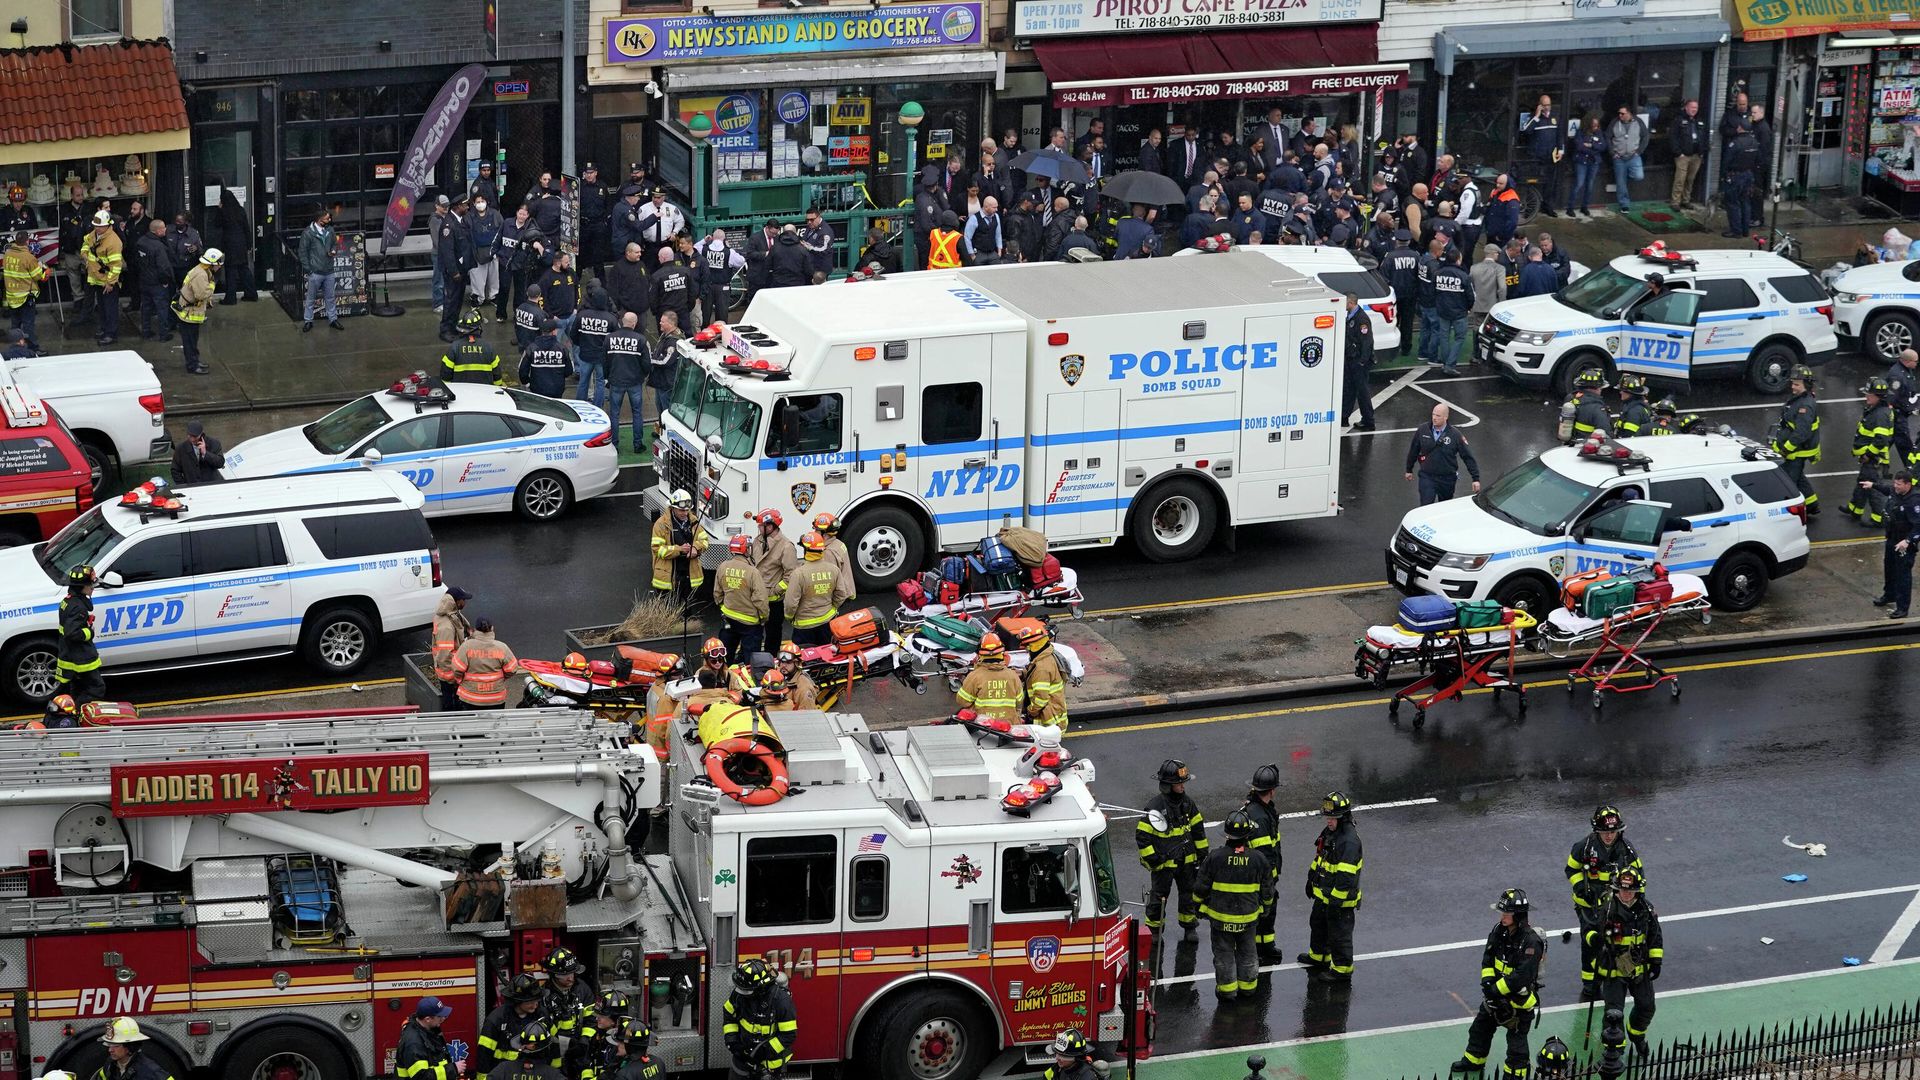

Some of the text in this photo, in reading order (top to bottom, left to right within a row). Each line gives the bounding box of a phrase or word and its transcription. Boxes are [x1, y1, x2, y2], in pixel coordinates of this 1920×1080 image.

[1023, 4, 1083, 17] OPEN 7 DAYS
[1795, 0, 1846, 16] FRUITS
[663, 18, 687, 27] LOTTO
[693, 17, 713, 26] SODA
[720, 16, 745, 25] CANDY
[752, 14, 794, 22] CIGARETTES
[801, 12, 823, 20] CIGAR
[850, 10, 867, 18] BEER
[874, 7, 922, 17] STATIONERIES
[927, 6, 941, 14] ETC
[1115, 11, 1285, 29] TEL: 718-840-5780 718-840-5831
[1320, 10, 1357, 20] DINER
[1026, 18, 1080, 31] 5am-10pm
[668, 24, 789, 49] NEWSSTAND
[794, 21, 837, 43] AND
[843, 16, 930, 40] GROCERY
[891, 36, 941, 46] 718-768-6845
[688, 48, 703, 56] AVE
[1312, 74, 1399, 89] FREE DELIVERY
[496, 83, 529, 93] OPEN
[1130, 80, 1289, 100] TEL: 718-840-5780 718-840-5831
[1063, 91, 1106, 102] 942 4th Ave
[1884, 91, 1912, 100] ATM
[215, 102, 232, 112] 946
[1883, 100, 1911, 108] INSIDE
[837, 105, 865, 118] ATM
[718, 114, 753, 131] LOTTERY
[1116, 124, 1140, 132] TACOS
[1022, 127, 1040, 136] 942
[718, 136, 754, 148] HERE.
[850, 147, 870, 157] 302
[929, 146, 943, 155] ATM
[375, 166, 394, 175] Open
[1263, 198, 1289, 211] NYPD
[1262, 205, 1288, 216] POLICE
[706, 250, 725, 260] NYPD
[1394, 257, 1416, 270] NYPD
[1436, 275, 1461, 286] NYPD
[581, 317, 608, 328] NYPD
[581, 324, 608, 333] POLICE
[1572, 328, 1596, 336] POLICE
[609, 337, 638, 347] NYPD
[610, 344, 638, 352] POLICE
[1628, 337, 1681, 360] NYPD
[533, 351, 563, 360] NYPD
[1108, 341, 1278, 380] POLICE
[1143, 377, 1222, 393] BOMB SQUAD
[1244, 411, 1322, 430] BOMB SQUAD 7091
[533, 443, 580, 454] SCHOOL SAFETY
[792, 452, 845, 467] POLICE
[924, 463, 1020, 499] NYPD
[1053, 481, 1115, 492] PROFESSIONALISM
[1511, 547, 1537, 558] POLICE
[361, 562, 377, 571] BOMB
[378, 559, 398, 569] SQUAD
[3, 606, 33, 620] POLICE
[100, 599, 184, 634] NYPD
[121, 764, 423, 805] LADDER 114 TALLY HO
[1227, 856, 1250, 867] FDNY
[391, 979, 456, 988] www.nyc.gov/fdny
[1025, 981, 1076, 999] God Bless
[78, 985, 154, 1016] FD NY
[1014, 990, 1086, 1012] JIMMY RICHES
[1018, 1022, 1051, 1033] September
[643, 1063, 660, 1079] FDNY
